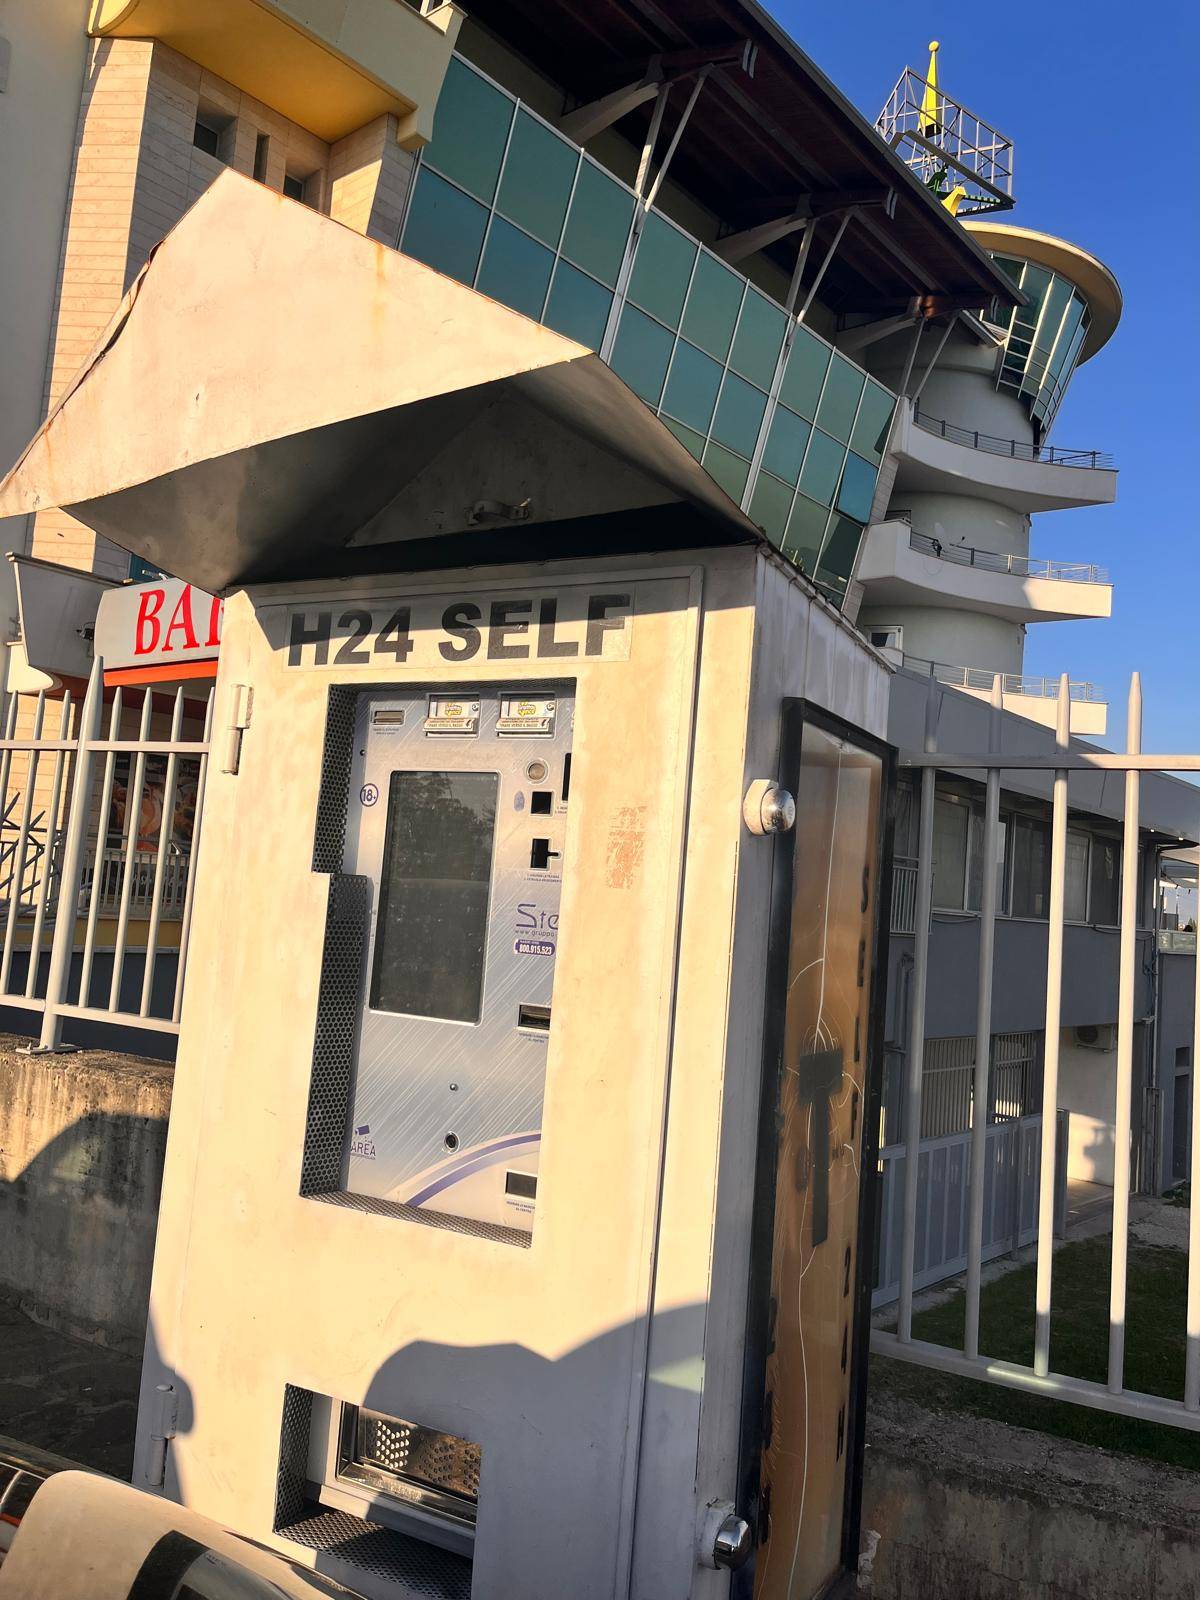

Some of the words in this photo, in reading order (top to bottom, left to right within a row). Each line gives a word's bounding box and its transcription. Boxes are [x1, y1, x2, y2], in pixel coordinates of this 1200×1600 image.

[288, 606, 414, 667] H24
[438, 594, 631, 663] SELF
[350, 1141, 376, 1157] AREA
